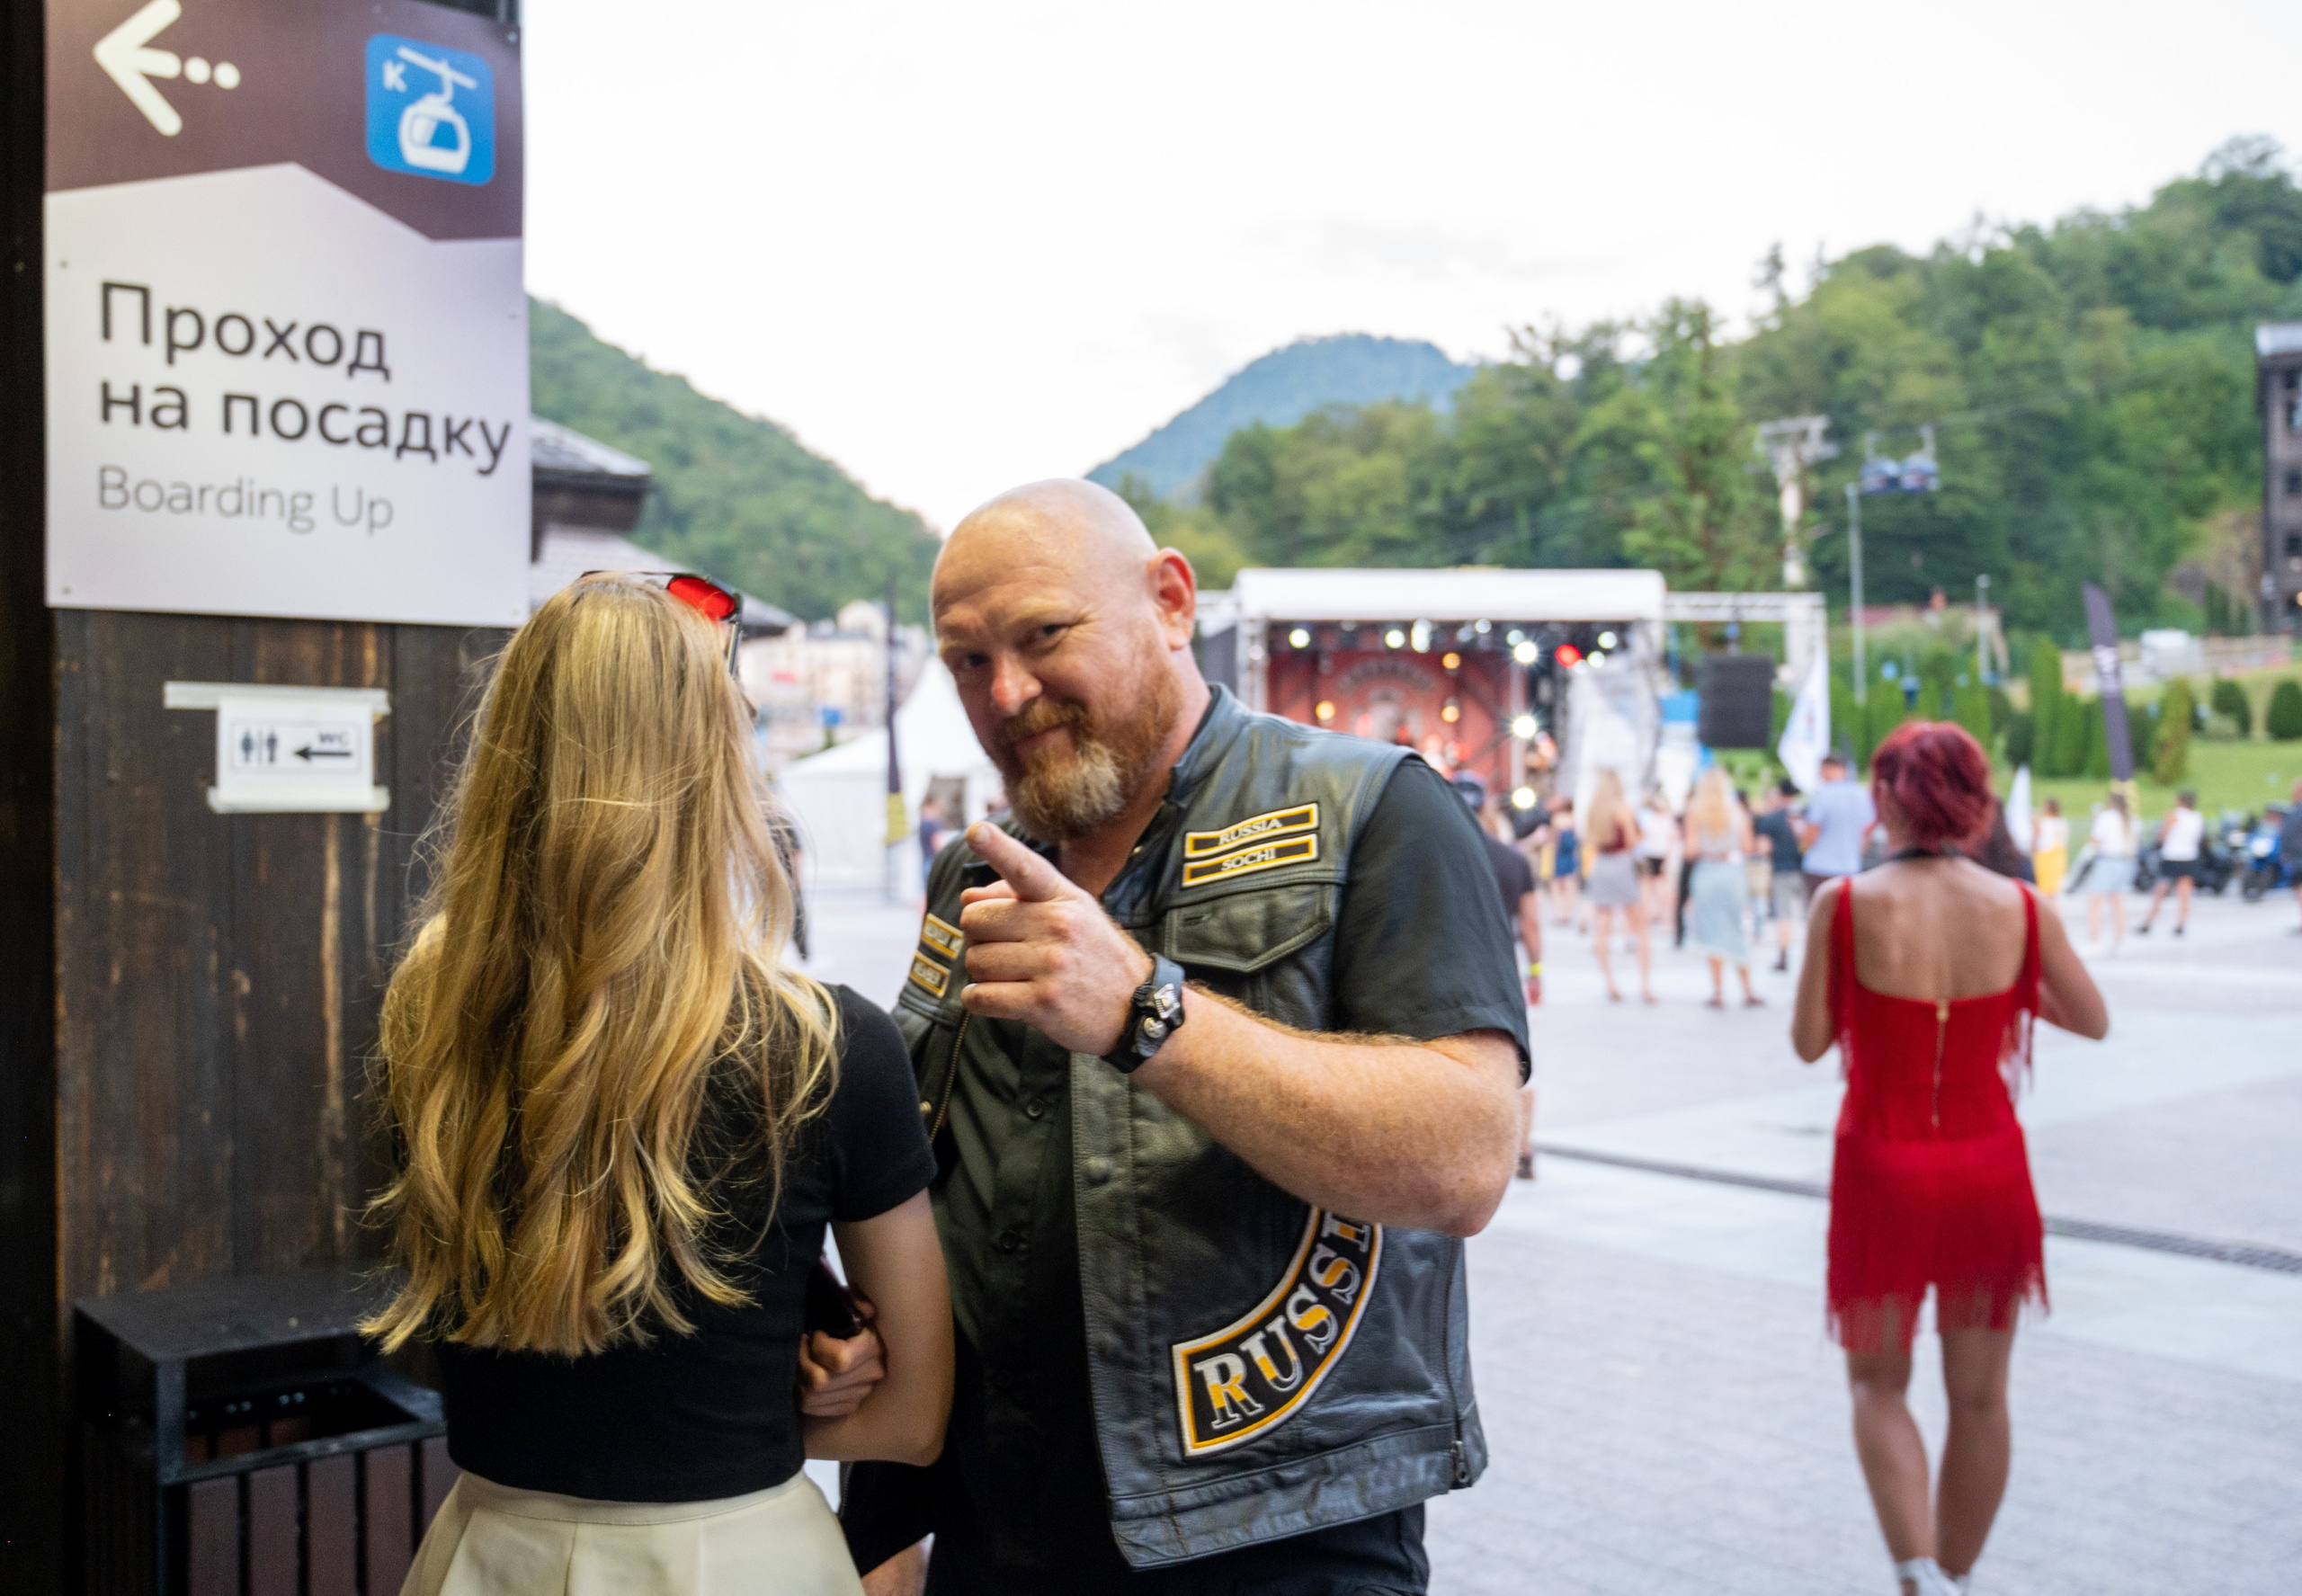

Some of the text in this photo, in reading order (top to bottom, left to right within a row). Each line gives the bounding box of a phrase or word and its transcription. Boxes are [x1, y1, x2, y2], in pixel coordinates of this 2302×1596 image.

[99, 281, 391, 382] Проход
[99, 380, 512, 477] на посадку
[98, 465, 394, 536] Boarding Up
[318, 731, 350, 745] WC
[1218, 818, 1283, 845] RUSSIA
[1221, 848, 1276, 871] SOCHI
